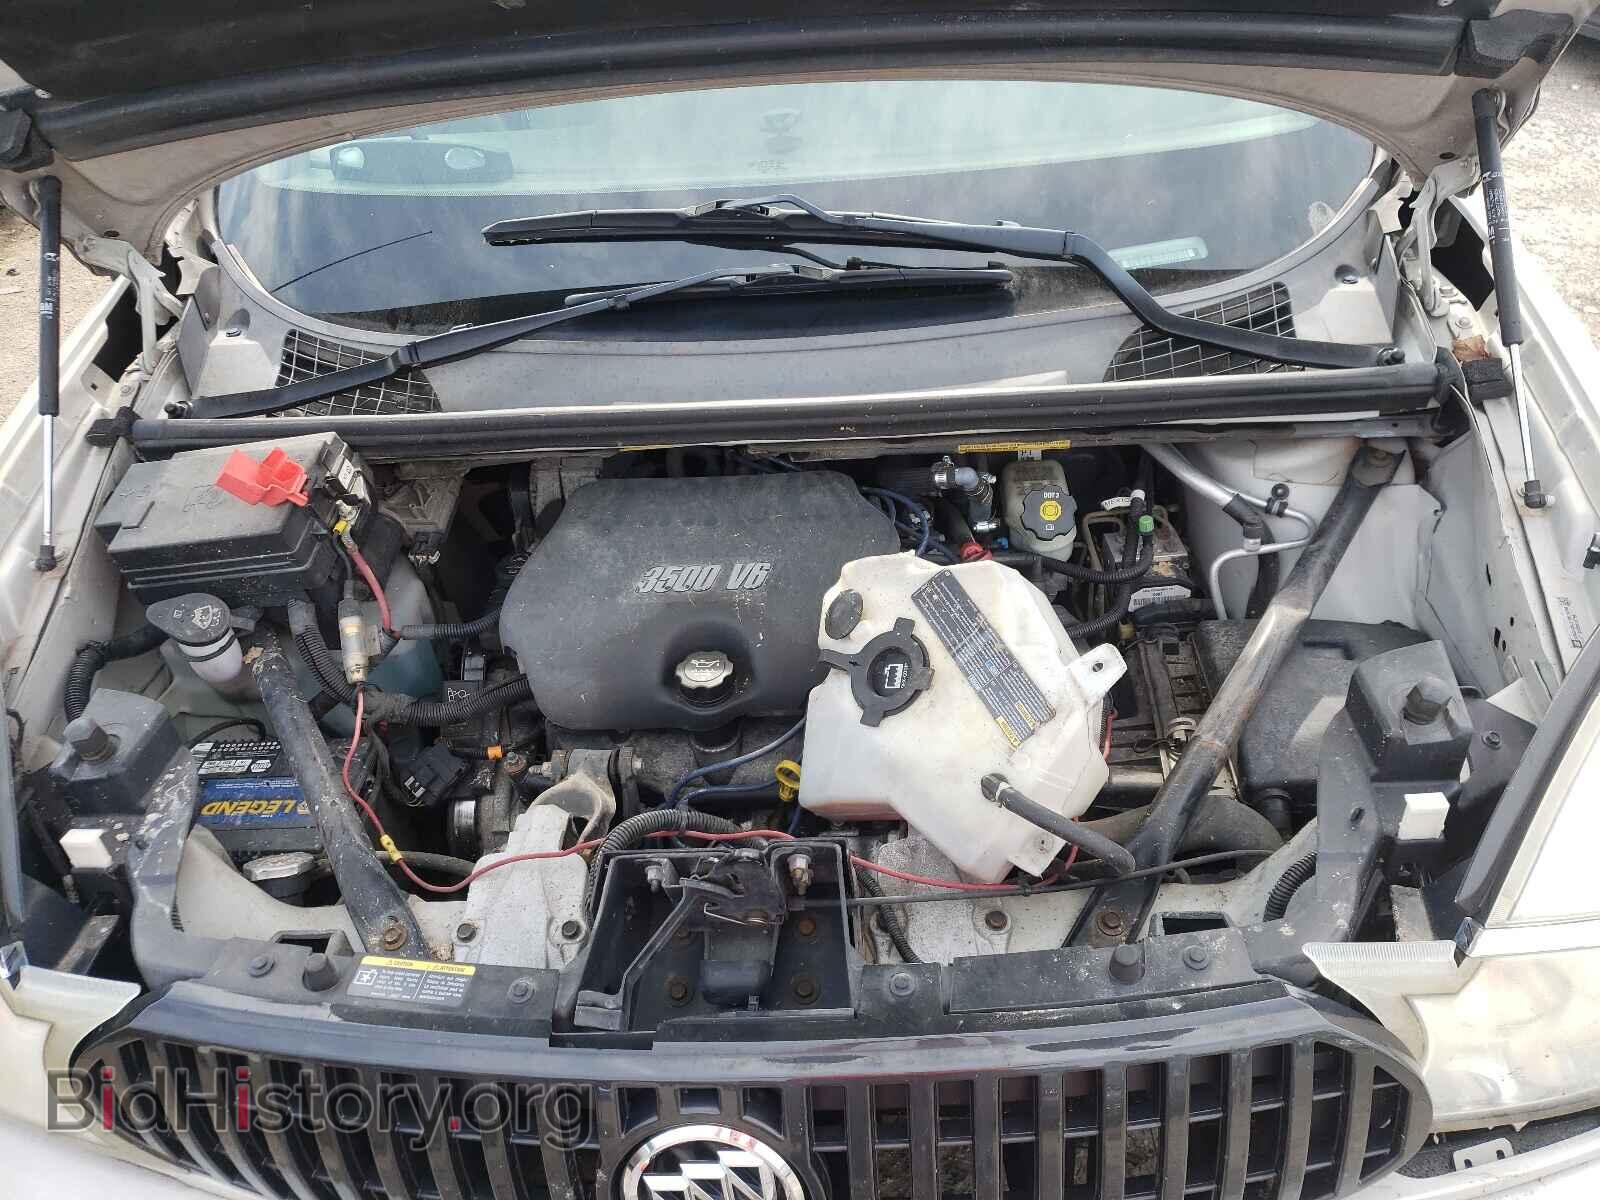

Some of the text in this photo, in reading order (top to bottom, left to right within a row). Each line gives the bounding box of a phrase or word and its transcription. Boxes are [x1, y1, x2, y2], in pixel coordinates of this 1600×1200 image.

[637, 562, 771, 593] 3500 V6
[201, 799, 296, 816] LEGEND
